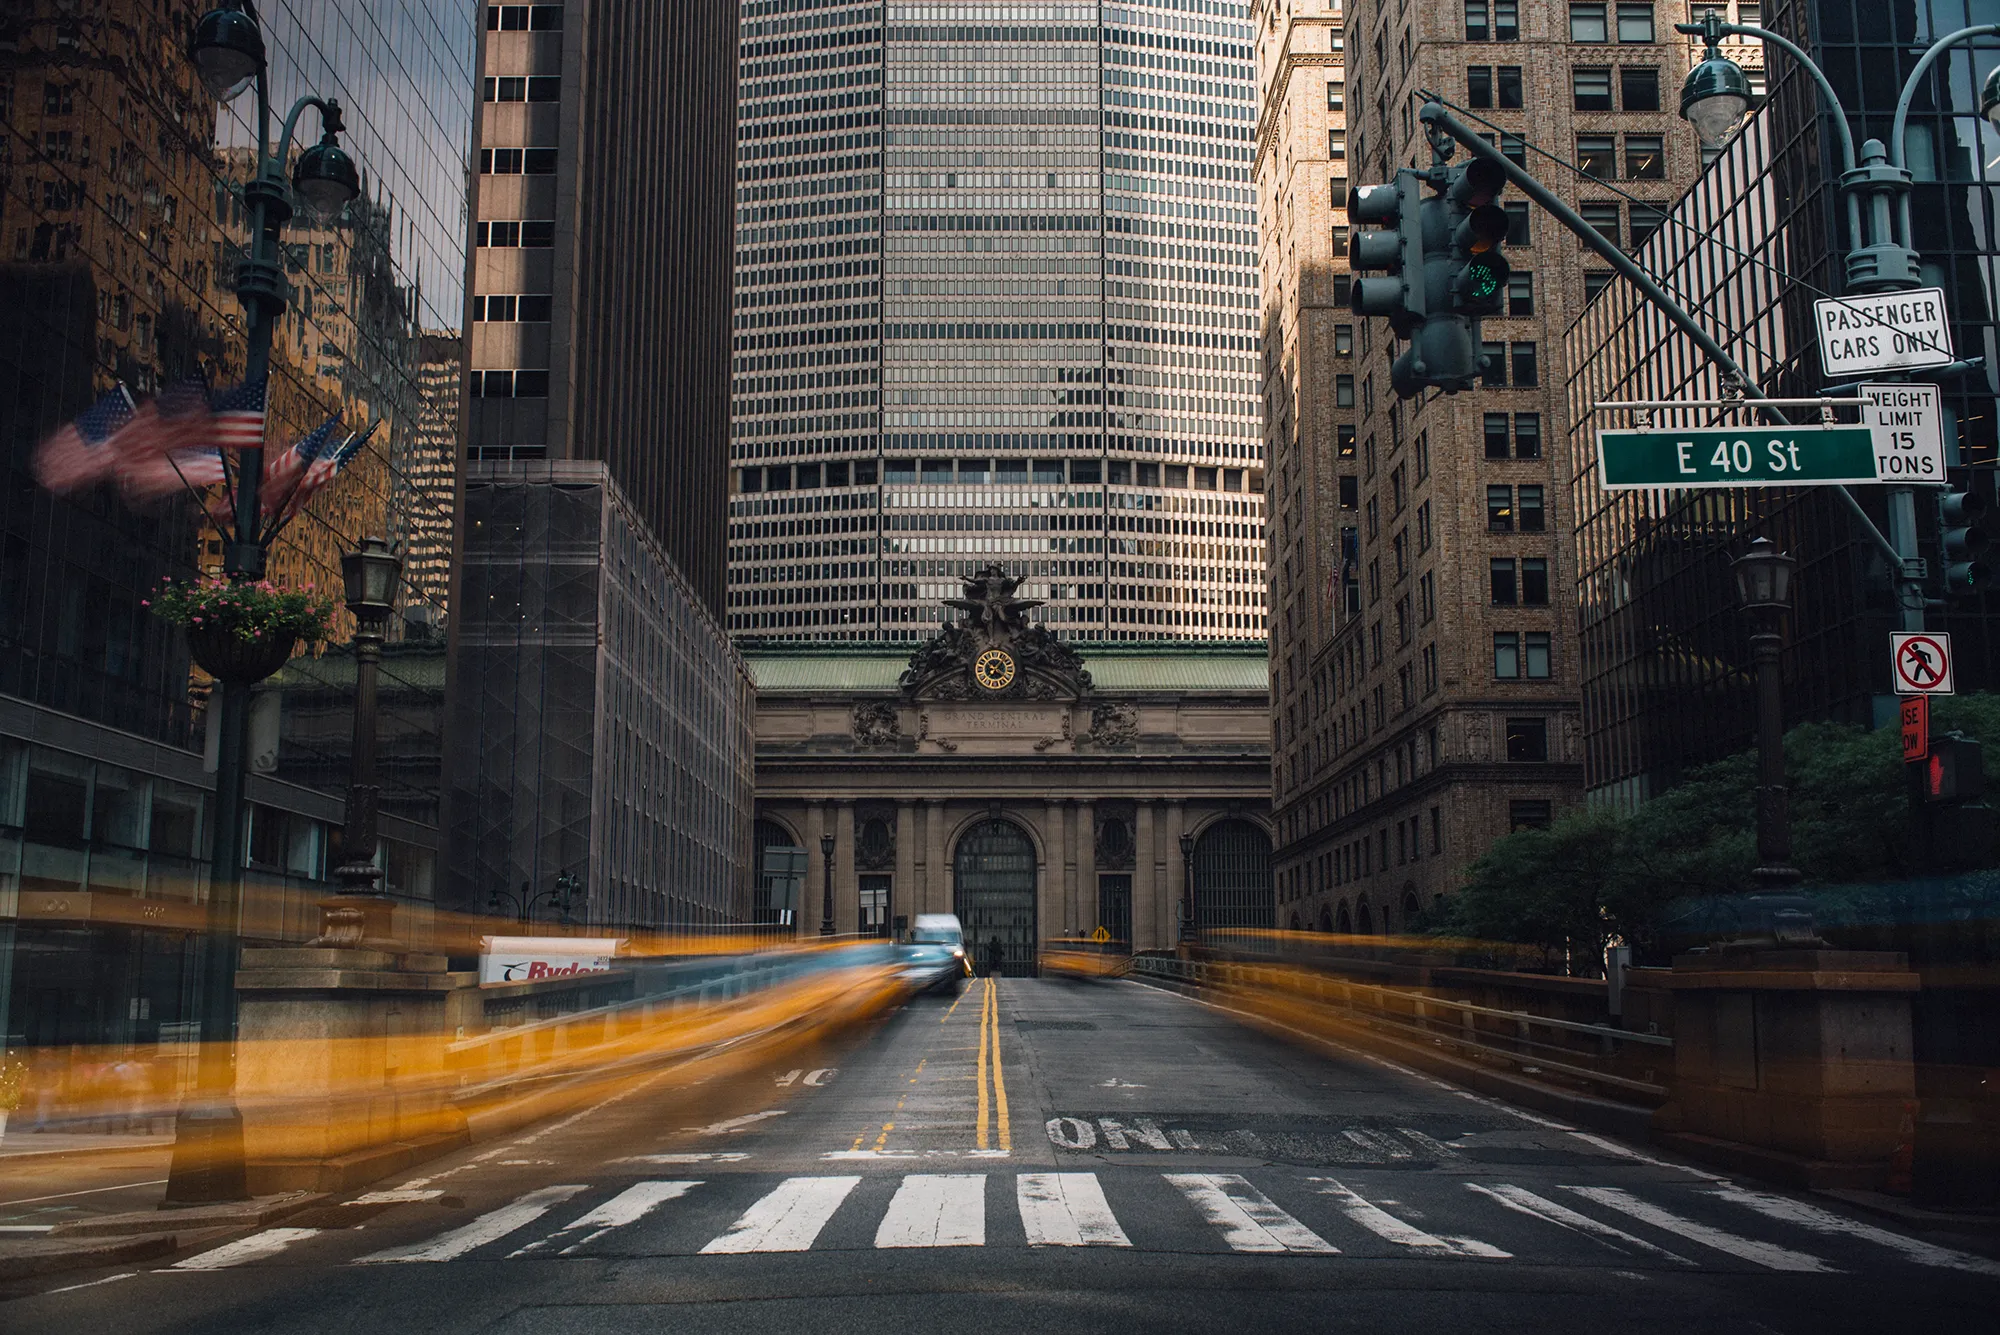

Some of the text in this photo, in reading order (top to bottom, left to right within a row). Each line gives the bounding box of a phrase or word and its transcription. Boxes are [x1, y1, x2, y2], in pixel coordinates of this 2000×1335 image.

[1826, 301, 1937, 331] PASSENGER
[1830, 330, 1940, 360] CARS ONLY
[1867, 393, 1931, 408] WEIGHT
[1879, 411, 1922, 427] LIMIT
[1890, 432, 1915, 450] 15
[1677, 440, 1802, 474] E 40 St
[1878, 456, 1934, 474] TONS
[944, 712, 1047, 720] GRAND CENTRAL
[966, 721, 1025, 729] TERMINAL
[527, 962, 605, 979] Ryd
